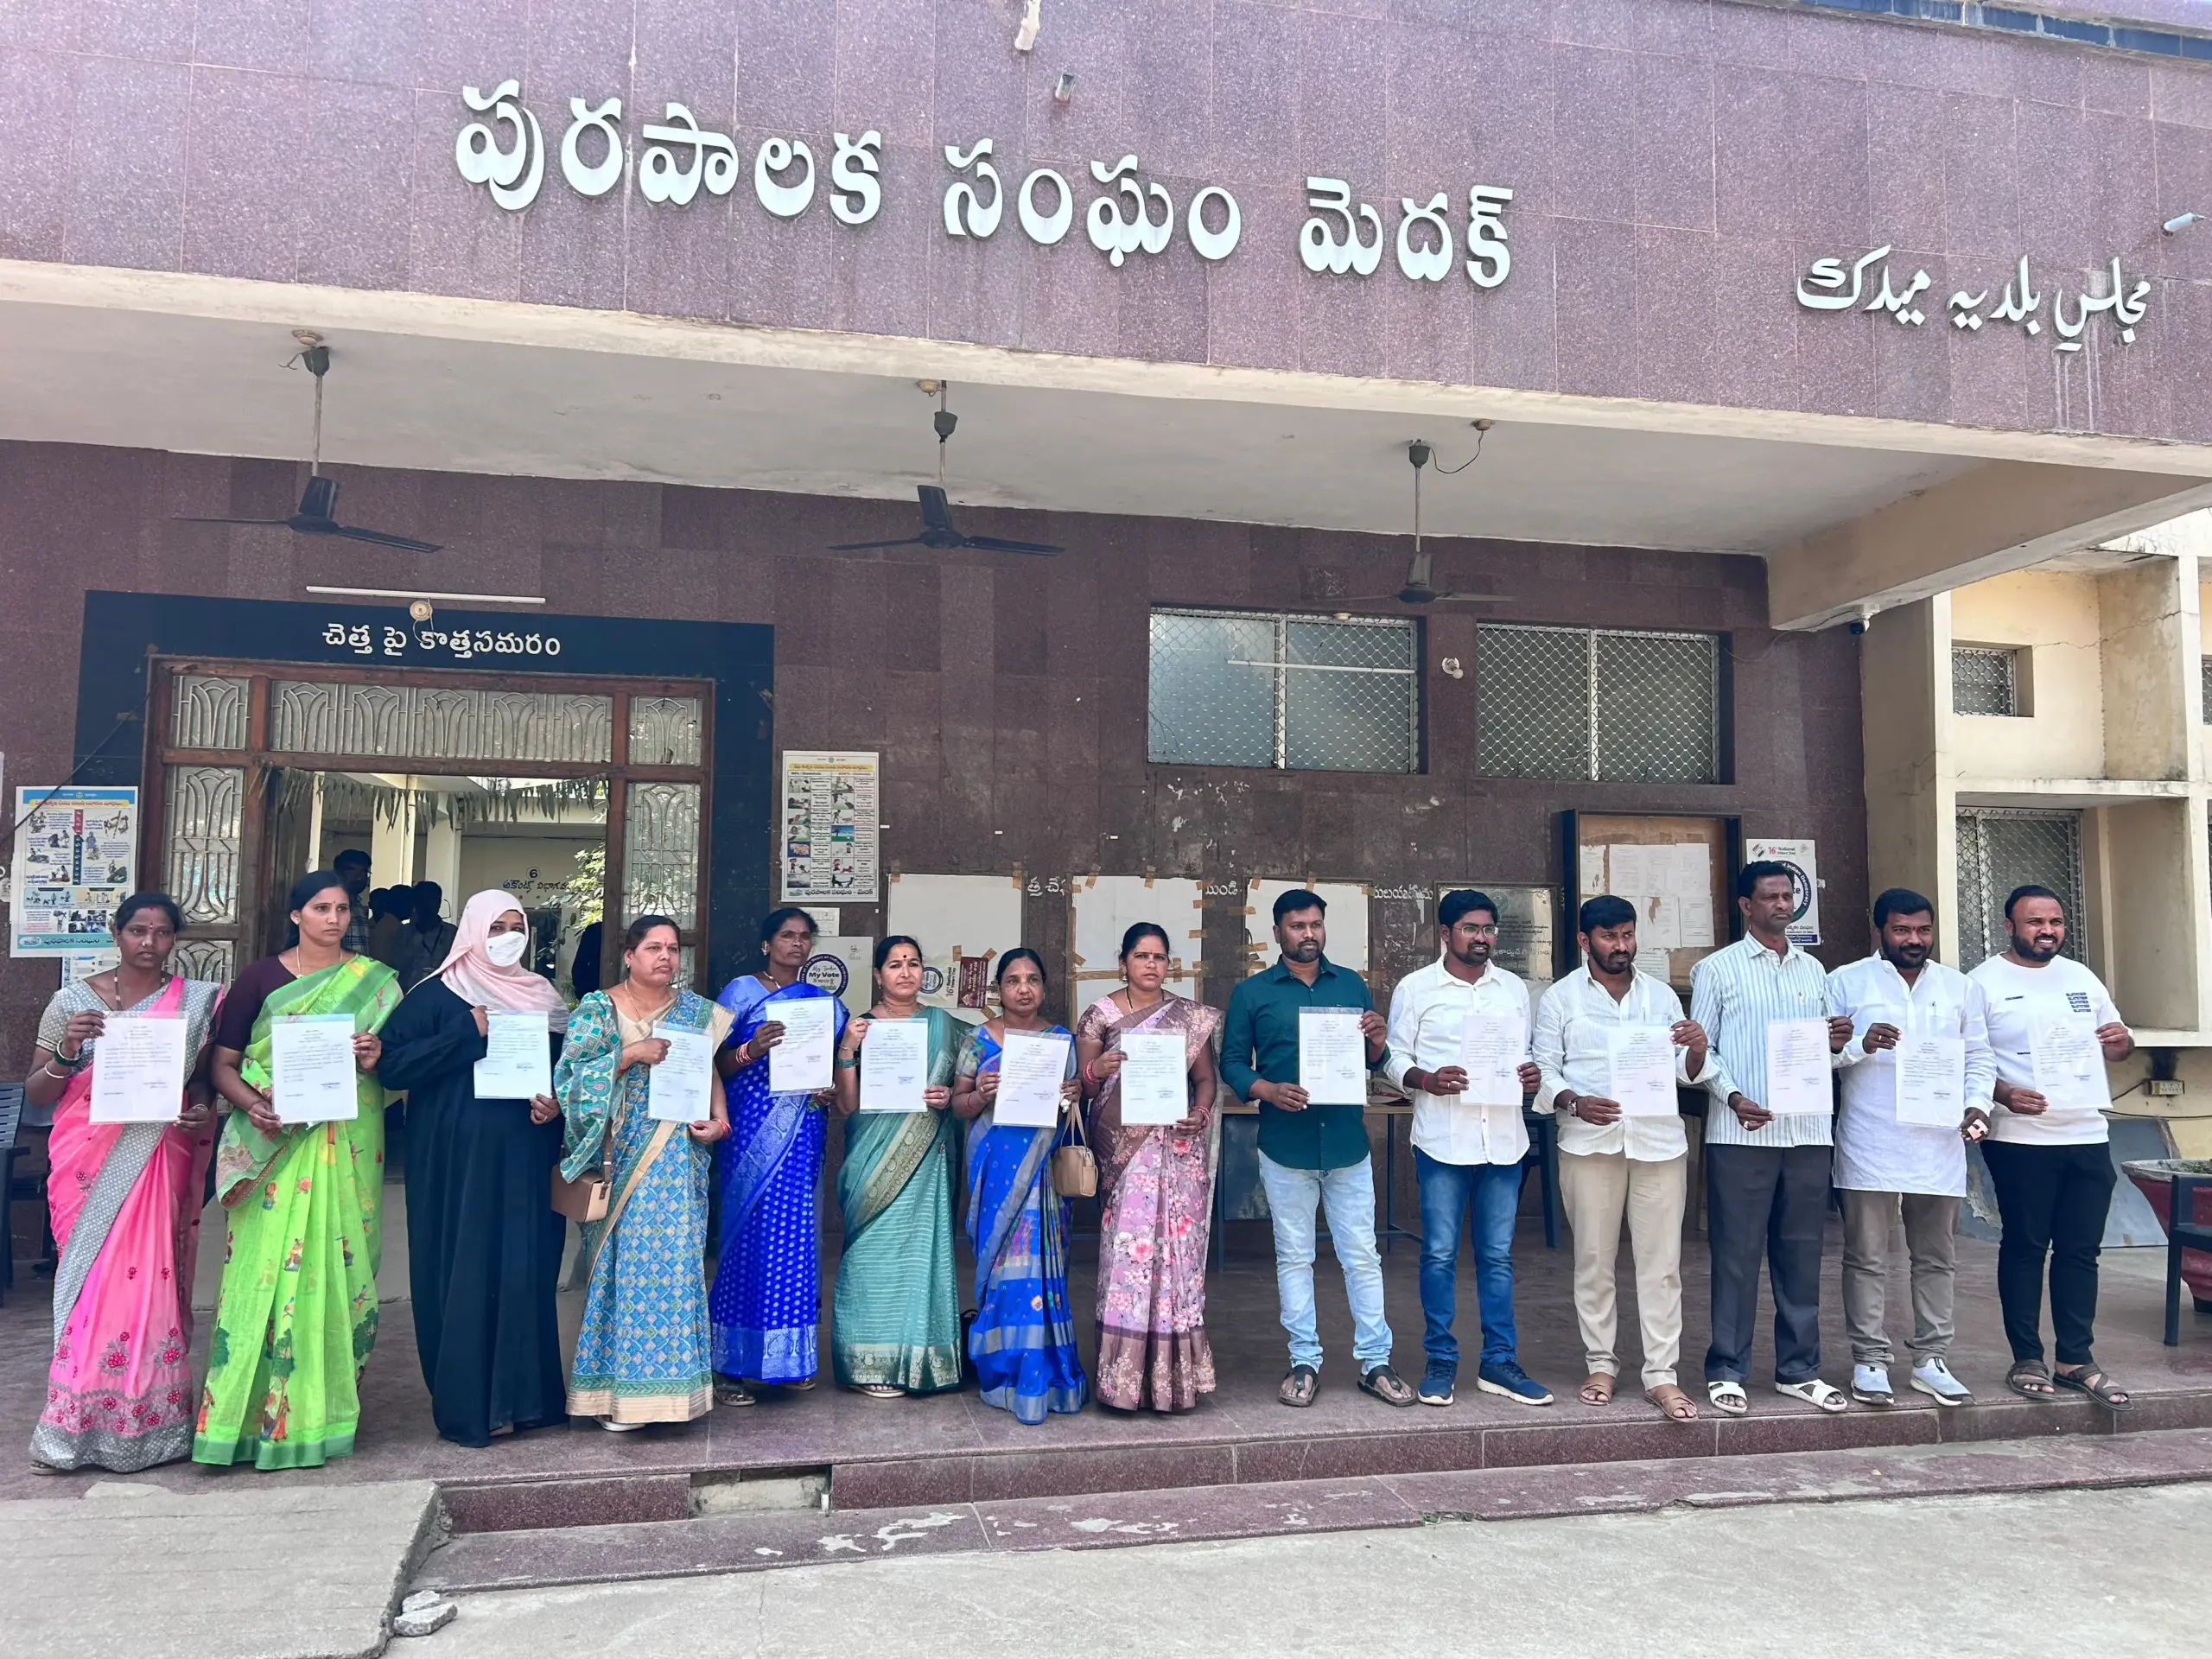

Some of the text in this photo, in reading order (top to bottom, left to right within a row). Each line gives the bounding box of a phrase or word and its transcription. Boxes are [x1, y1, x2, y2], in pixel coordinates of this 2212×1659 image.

[454, 79, 1514, 289] పురపాలక సంఘం మెదక్
[322, 623, 561, 659] చెత్త పై కొత్తసమరం
[529, 868, 538, 878] 6
[1800, 874, 1809, 906] Democracy
